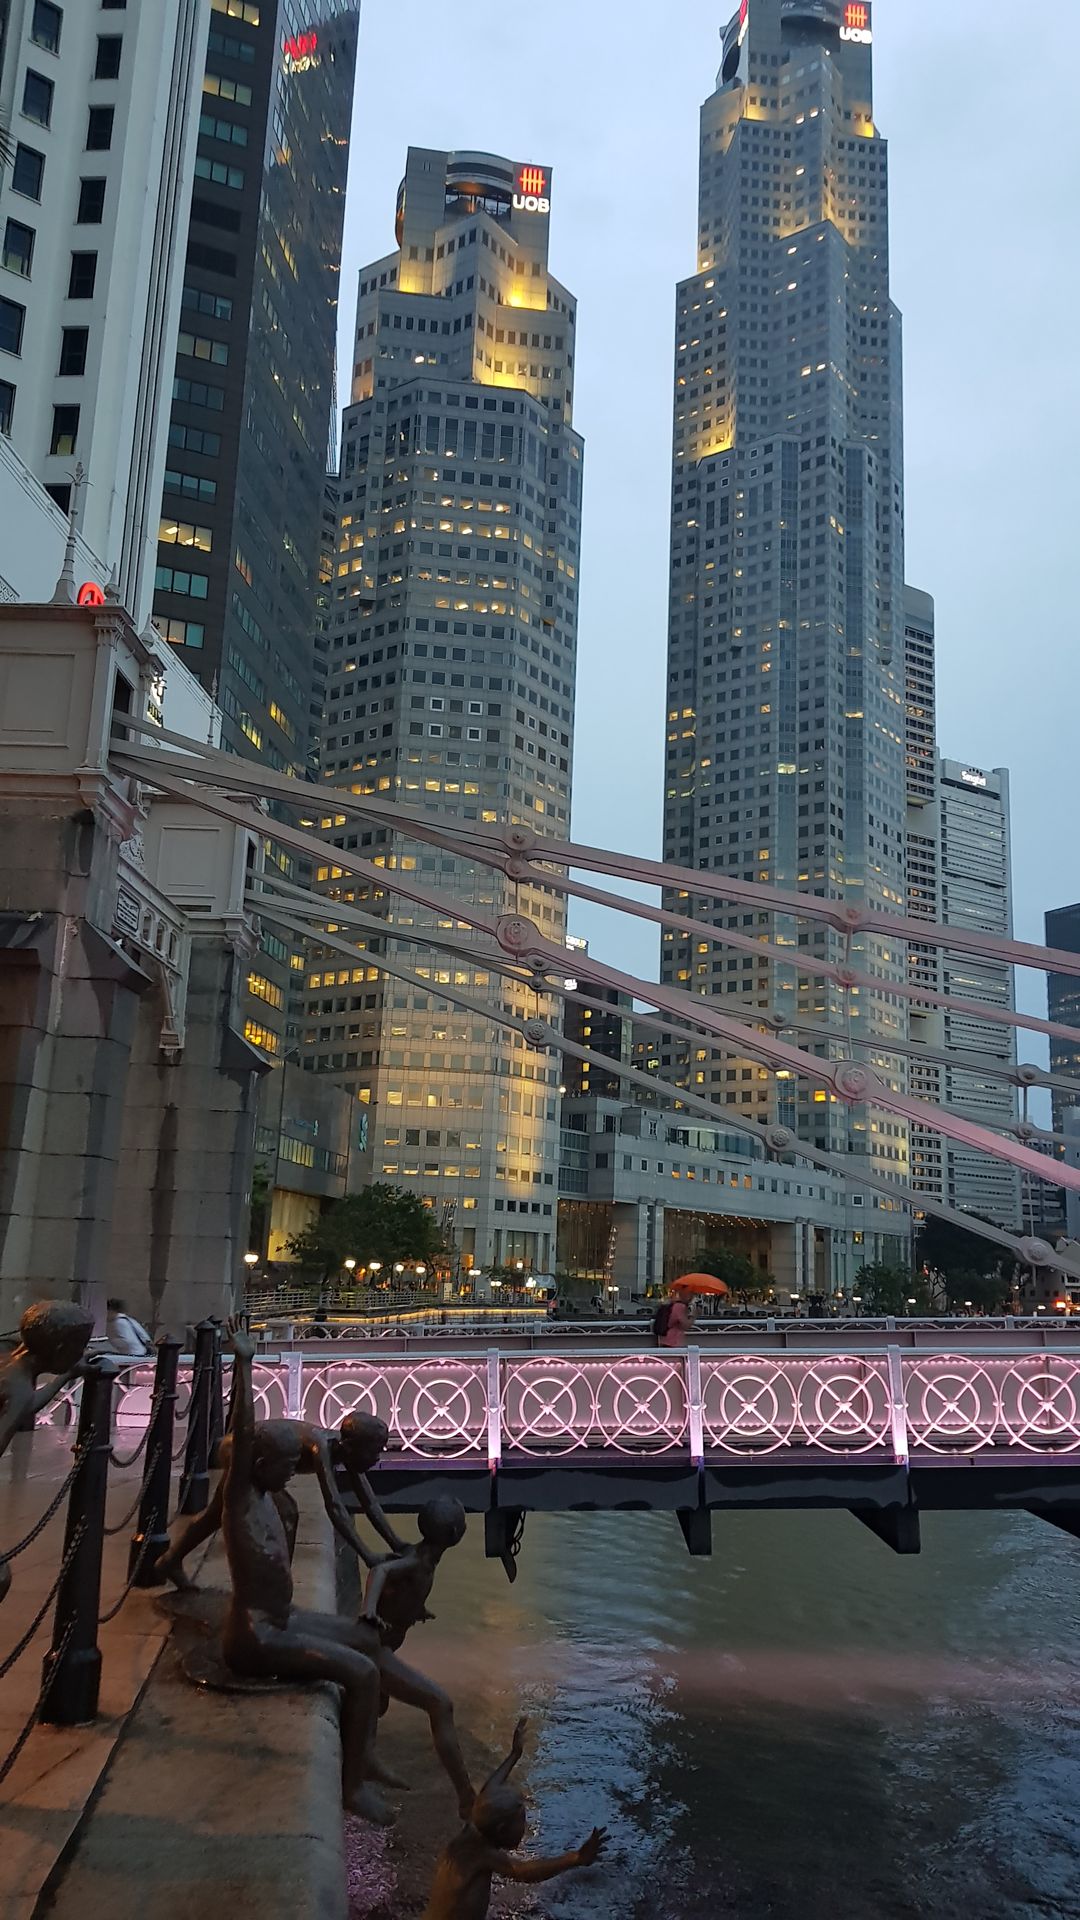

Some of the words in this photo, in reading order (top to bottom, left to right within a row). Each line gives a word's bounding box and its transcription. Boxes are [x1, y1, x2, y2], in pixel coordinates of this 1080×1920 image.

[839, 26, 872, 44] UOB
[513, 194, 549, 213] UOB
[961, 770, 986, 786] Singtel
